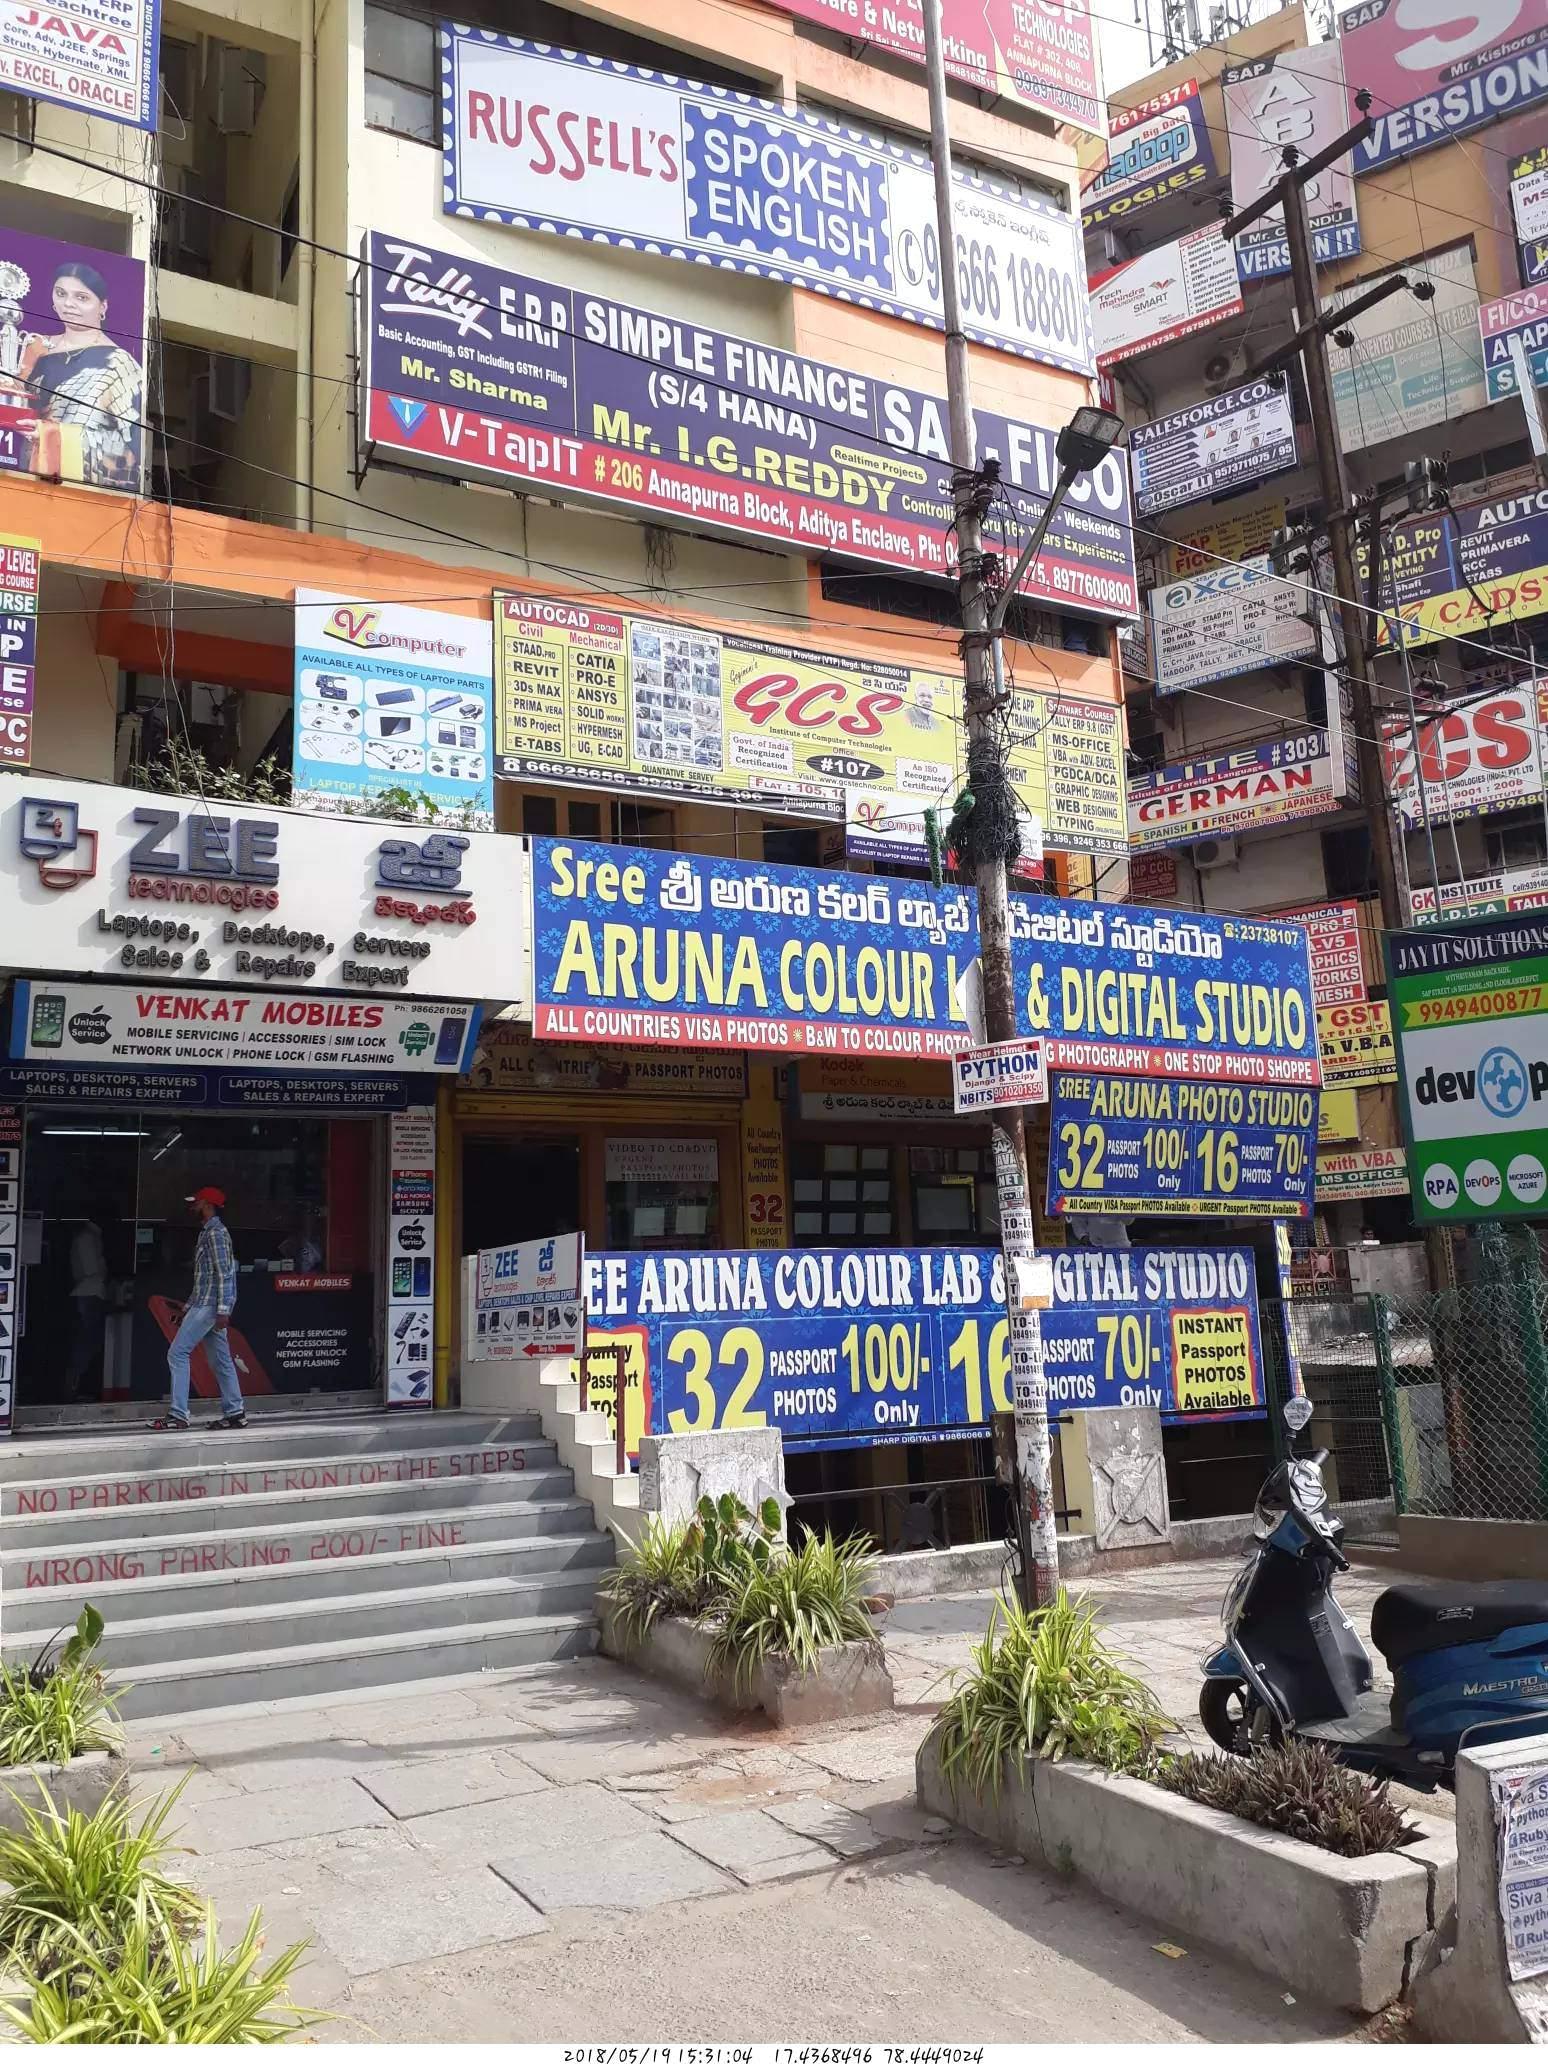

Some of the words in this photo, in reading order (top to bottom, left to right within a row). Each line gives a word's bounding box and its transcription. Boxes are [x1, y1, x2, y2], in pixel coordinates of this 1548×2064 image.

[16, 10, 127, 54] JAVA
[1012, 5, 1090, 60] TECHNOLOGIES
[1345, 3, 1386, 30] SAP
[89, 47, 131, 68] Springs
[1477, 33, 1536, 67] Kishore
[13, 61, 63, 90] EXCEL,
[68, 76, 135, 111] ORACLE
[1226, 64, 1266, 82] SAP
[704, 129, 871, 218] SPOKEN
[708, 183, 877, 266] ENGLISH
[379, 244, 493, 340] Tally
[500, 286, 566, 349] E.R.P
[1007, 253, 1078, 346] 18880
[378, 325, 402, 342] Basic
[405, 332, 456, 358] Accounting,
[457, 345, 475, 360] GST
[476, 349, 514, 373] Including
[545, 369, 567, 387] Filing
[584, 302, 716, 377] SIMPLE
[725, 343, 868, 419] FINANCE
[400, 356, 441, 383] Mr.
[449, 368, 548, 411] Sharma
[648, 372, 708, 413] (S/4
[718, 390, 817, 450] HANA)
[593, 404, 661, 455] Mr.
[678, 426, 896, 513] I.G.REDDY
[834, 449, 879, 469] Realtime
[883, 461, 924, 481] Projects
[438, 408, 583, 476] V-TapIT
[611, 459, 643, 491] 206
[648, 469, 739, 516] Annapurna
[744, 492, 794, 532] Block,
[798, 505, 848, 541] Aditya
[852, 518, 914, 561] Enclave,
[1053, 568, 1132, 606] 8977600800
[1153, 481, 1193, 504] Oscar
[1065, 513, 1121, 540] Weekends
[7, 551, 36, 574] LEVEL
[1064, 536, 1126, 564] Experience
[1461, 534, 1530, 560] PRIMAVERA
[6, 576, 35, 589] COURSE
[509, 603, 589, 628] AUTOCAD
[569, 633, 621, 651] Mechanical
[302, 653, 353, 670] AVAILABLE
[375, 665, 404, 677] TYPES
[420, 670, 455, 685] LAPTOP
[457, 678, 485, 690] PARTS
[513, 661, 559, 678] REVIT
[576, 653, 616, 671] CATIA
[576, 670, 616, 688] PRO-E
[514, 717, 527, 729] MS
[530, 720, 561, 733] Project
[577, 724, 623, 740] HYPERMESH
[514, 738, 561, 752] E-TABS
[1052, 735, 1111, 753] MS-OFFICE
[1055, 799, 1081, 814] WEB
[1139, 764, 1313, 822] GERMAN
[1056, 816, 1094, 832] TYPING
[1143, 824, 1188, 840] SPANISH
[1211, 808, 1255, 826] FRENCH
[1281, 791, 1332, 812] JAPANESE
[131, 808, 279, 878] ZEE
[551, 847, 645, 905] Sree
[660, 861, 701, 912] శ్రీ
[711, 876, 810, 917] అరుణ
[818, 882, 892, 924] కలర్
[128, 876, 279, 911] technologies
[99, 909, 199, 943] Laptops,
[223, 922, 334, 953] Desktops,
[353, 933, 431, 958] Servers
[121, 945, 183, 969] Sales
[195, 950, 210, 970] &
[236, 952, 316, 978] Repairs
[342, 961, 408, 987] Expert
[553, 920, 768, 1008] ARUNA
[781, 940, 935, 1020] COLOUR
[1028, 962, 1050, 1030] &
[1062, 967, 1186, 1040] DIGITAL
[1195, 979, 1306, 1050] STUDIO
[136, 994, 249, 1023] VENKAT
[262, 1002, 383, 1027] MOBILES
[411, 1005, 467, 1016] 9866261058
[1331, 1005, 1386, 1026] GST
[1420, 989, 1541, 1022] 9949400877
[113, 1044, 171, 1058] NETWORK
[175, 1047, 223, 1059] UNLOCK
[233, 1048, 271, 1061] PHONE
[275, 1050, 305, 1061] LOCK
[315, 1051, 338, 1062] GSM
[341, 1052, 394, 1063] FLASHING
[127, 1027, 173, 1040] MOBILE
[176, 1029, 239, 1042] SERVICING
[249, 1033, 326, 1045] ACCESSORIES
[334, 1035, 356, 1046] SIM
[359, 1036, 386, 1047] LOCK
[546, 1009, 578, 1033] ALL
[584, 1011, 680, 1039] COUNTRIES
[686, 1018, 721, 1040] VISA
[727, 1020, 788, 1045] PHOTOS
[806, 1028, 836, 1047] B&W
[841, 1030, 860, 1049] TO
[864, 1031, 921, 1052] COLOUR
[1058, 1044, 1150, 1069] PHOTOGRAPHY
[1164, 1051, 1190, 1071] ONE
[1193, 1053, 1221, 1073] STOP
[1226, 1056, 1265, 1077] PHOTO
[1268, 1058, 1312, 1080] SHOPPE
[960, 1054, 1038, 1080] PYTHON
[960, 1091, 992, 1104] NBITS
[1058, 1078, 1090, 1098] SREE
[1090, 1080, 1172, 1120] ARUNA
[1178, 1084, 1243, 1122] PHOTO
[1248, 1090, 1312, 1126] STUDIO
[1059, 1122, 1104, 1189] 32
[1143, 1127, 1189, 1169] 100/-
[1197, 1131, 1239, 1192] 16
[1275, 1134, 1308, 1174] 70/-
[1325, 1158, 1358, 1172] with
[1362, 1152, 1396, 1169] VBA
[1426, 1178, 1457, 1197] RPA
[1466, 1175, 1501, 1188] DEVOPS
[638, 1256, 767, 1313] ARUNA
[775, 1253, 913, 1309] COLOUR
[922, 1255, 982, 1305] LAB
[1145, 1252, 1247, 1302] STUDIO
[1178, 1318, 1244, 1334] INSTANT
[770, 1349, 837, 1376] PASSPORT
[842, 1322, 930, 1393] 100/-
[1097, 1313, 1160, 1380] 70/-
[1181, 1344, 1245, 1361] Passport
[1184, 1367, 1245, 1383] PHOTOS
[774, 1388, 836, 1416] PHOTOS
[18, 1488, 57, 1515] NO
[70, 1477, 206, 1510] PARKING
[223, 1474, 248, 1495] IN
[450, 1448, 526, 1475] STEPS
[26, 1554, 144, 1588] WRONG
[160, 1538, 291, 1576] PARKING
[401, 1523, 465, 1550] FINE
